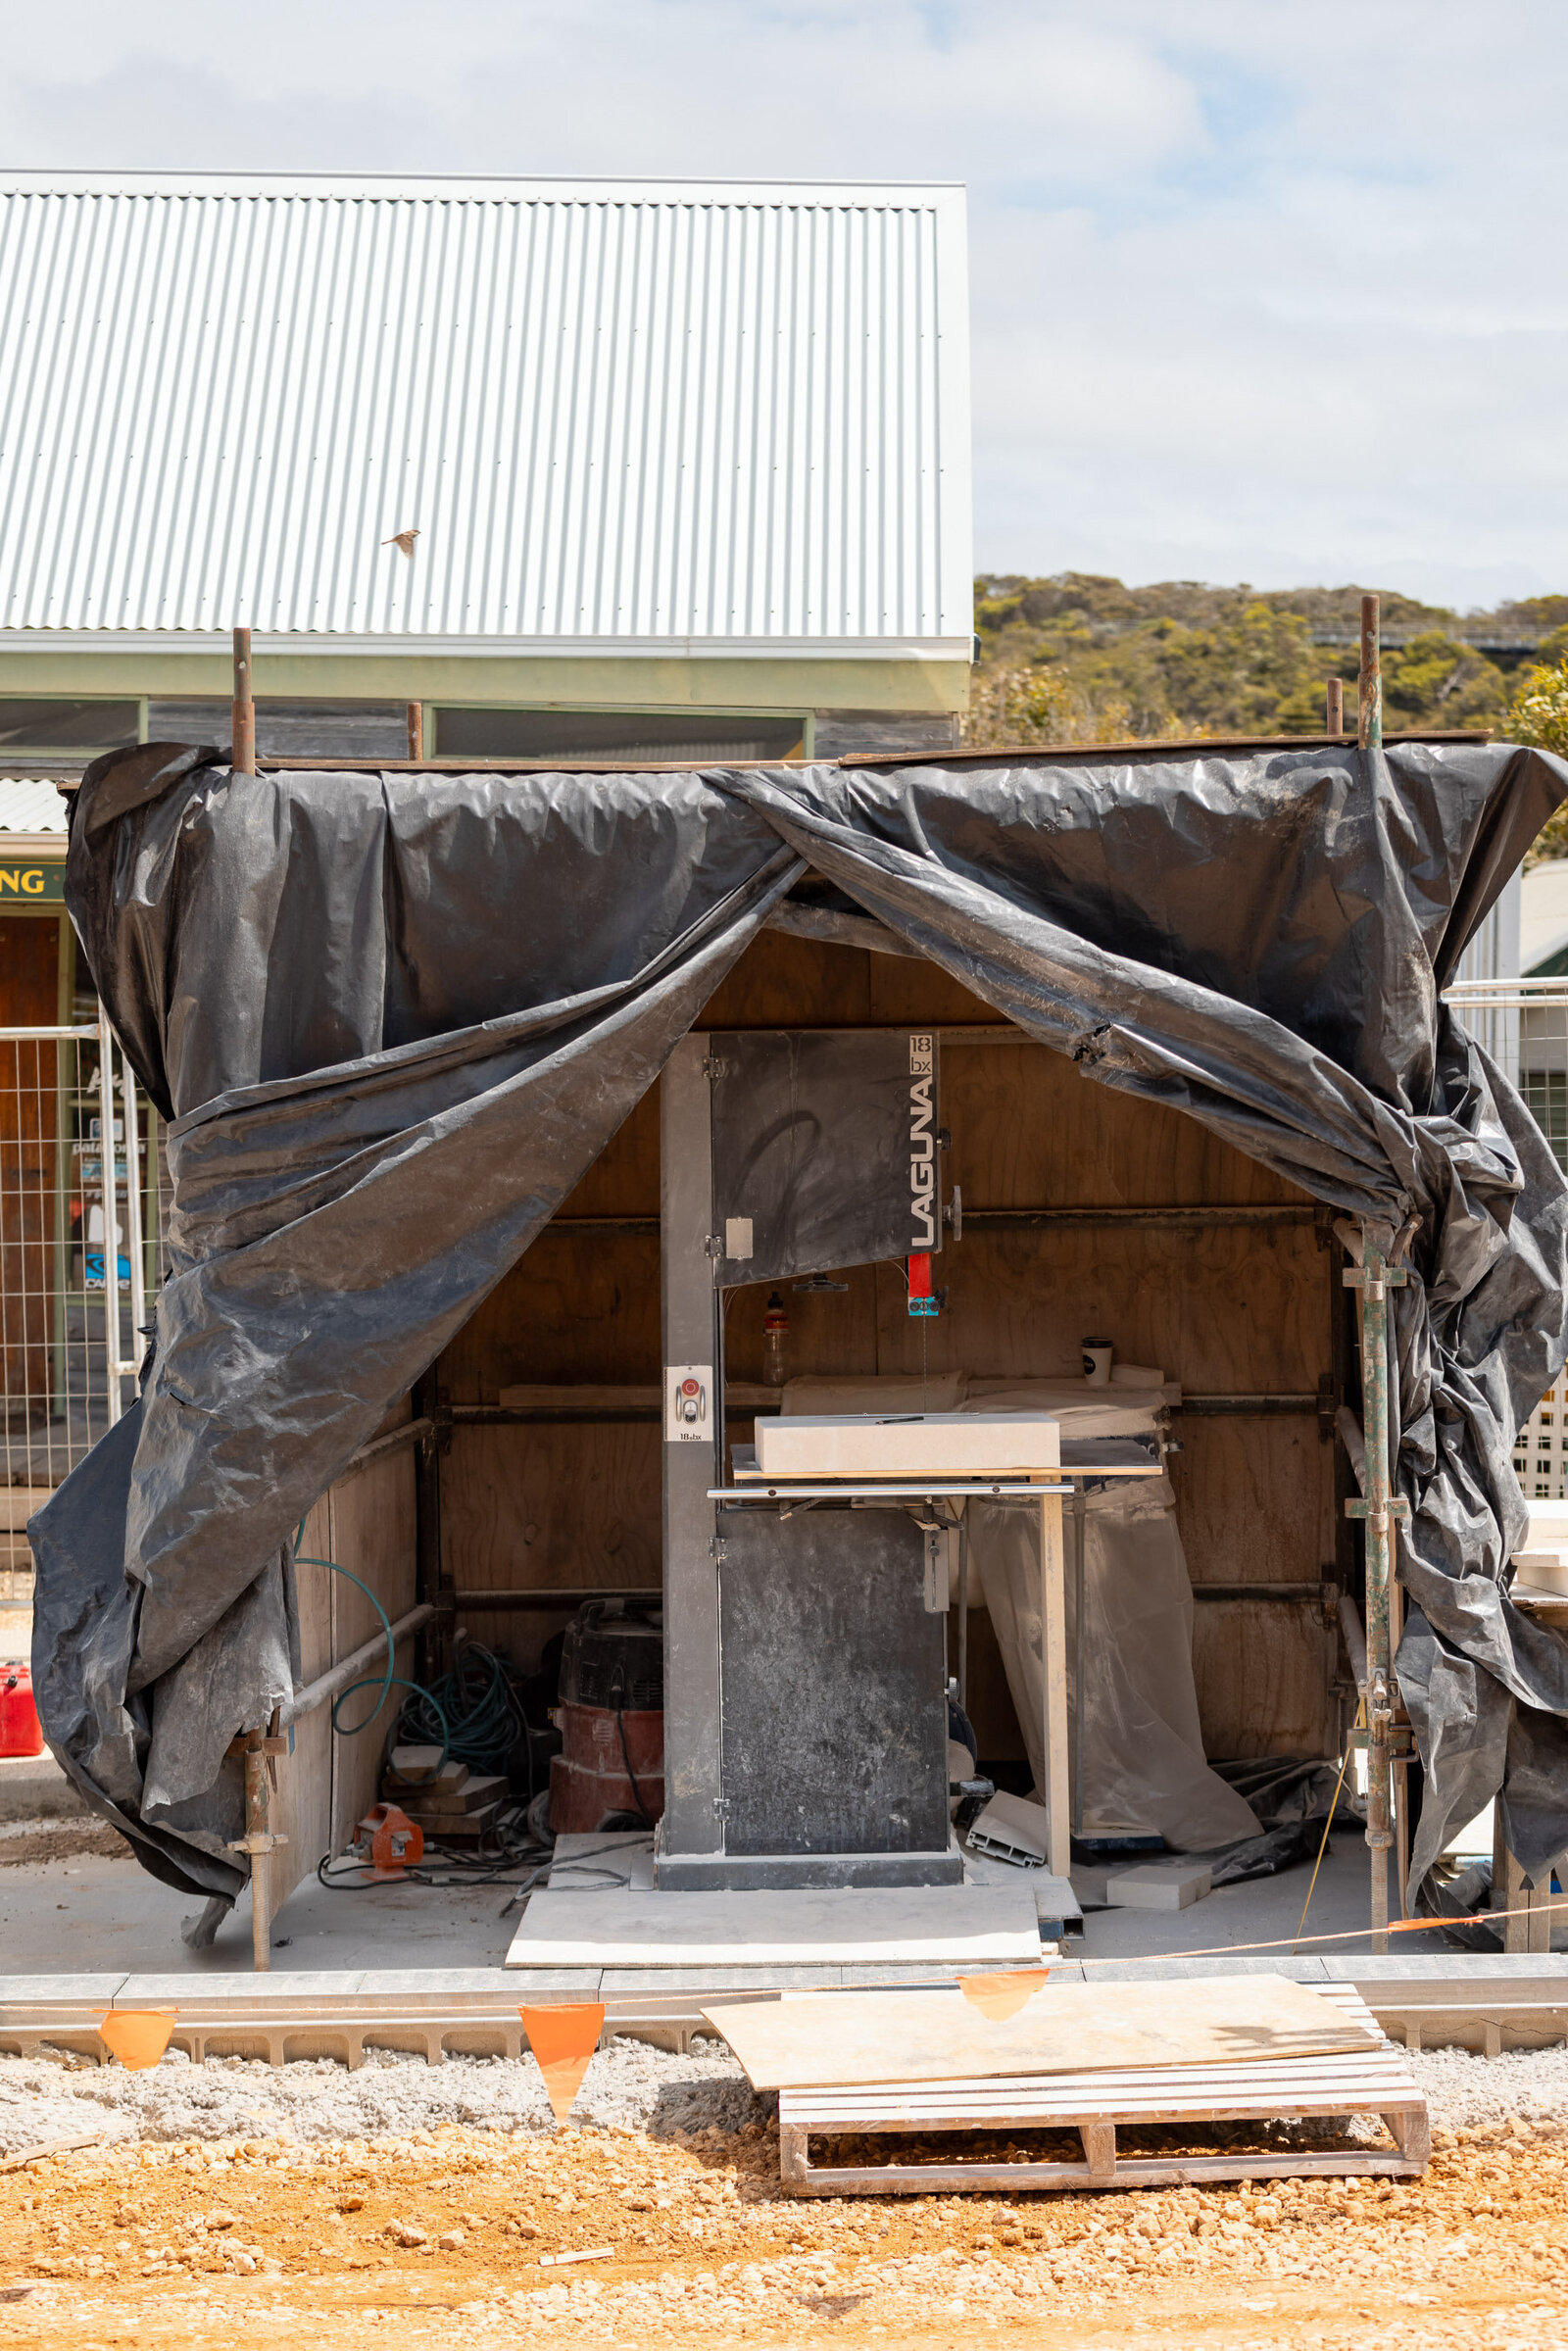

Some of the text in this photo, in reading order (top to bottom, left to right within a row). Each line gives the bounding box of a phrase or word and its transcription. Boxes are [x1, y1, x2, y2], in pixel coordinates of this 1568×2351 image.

[0, 869, 45, 894] NG
[911, 1037, 931, 1053] 18
[911, 1056, 931, 1072] bx
[909, 1075, 934, 1247] LAGUNA
